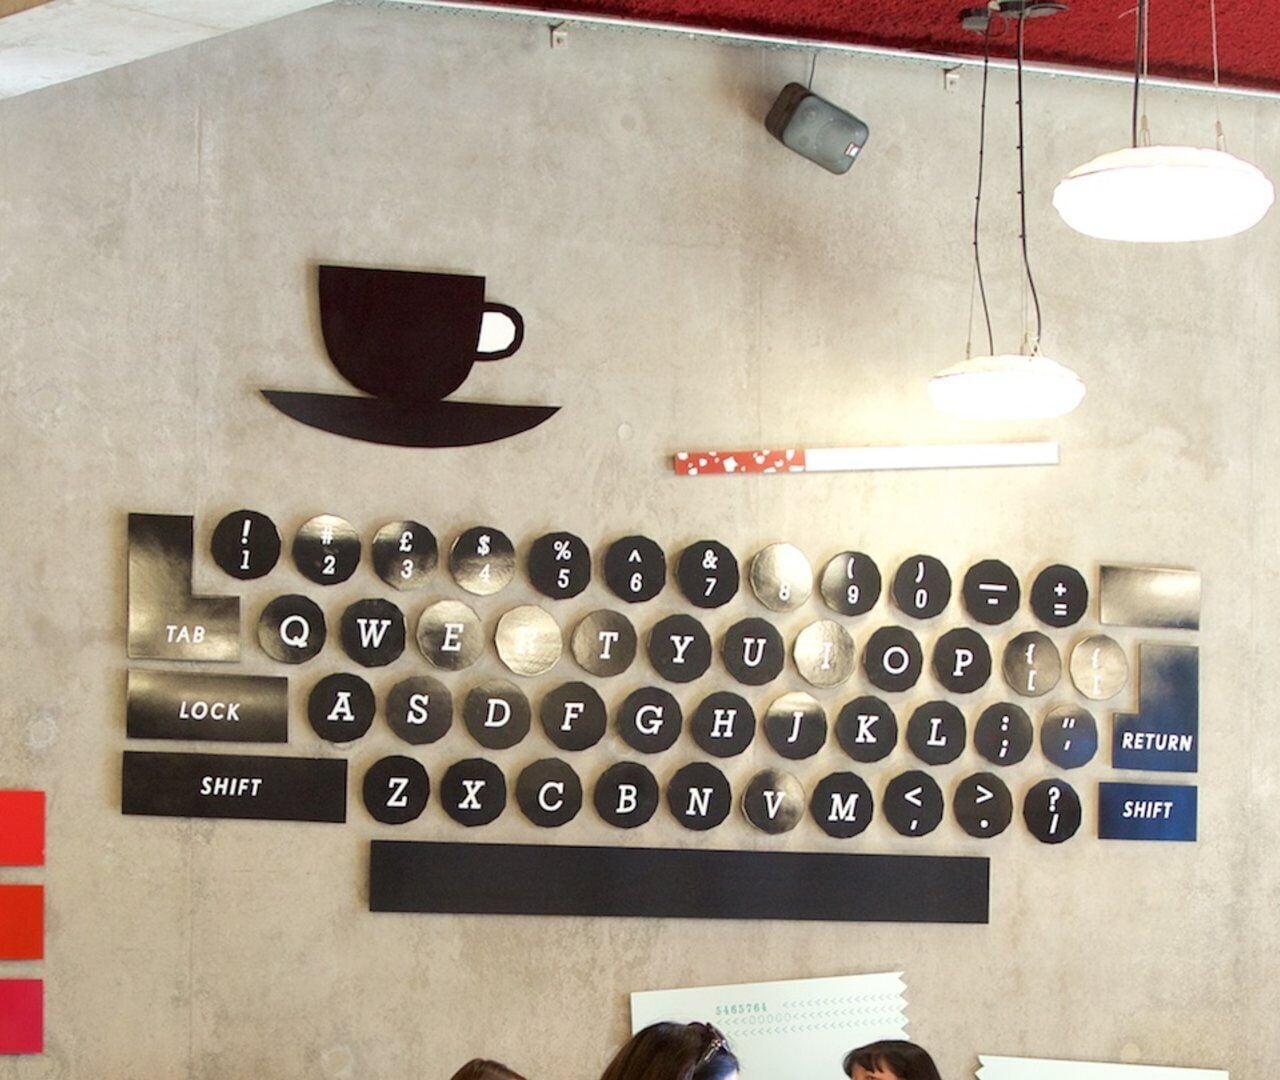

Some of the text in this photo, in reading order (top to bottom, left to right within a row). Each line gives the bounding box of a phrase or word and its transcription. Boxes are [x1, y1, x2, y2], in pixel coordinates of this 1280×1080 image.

[241, 519, 251, 544] !
[320, 526, 334, 546] #
[399, 531, 413, 552] £
[477, 534, 491, 557] $
[240, 549, 250, 570] 1
[553, 540, 572, 561] %
[702, 549, 718, 570] &
[322, 555, 336, 575] 2
[400, 559, 414, 580] 3
[477, 562, 492, 586] 4
[557, 568, 570, 589] 5
[630, 572, 643, 592] 6
[704, 577, 717, 597] 7
[778, 584, 791, 601] 8
[847, 585, 859, 604] 9
[915, 588, 928, 609] 0
[165, 624, 206, 644] TAB
[280, 615, 309, 648] Q
[356, 618, 392, 648] W
[440, 622, 466, 653] E
[598, 631, 619, 660] T
[670, 635, 694, 664] Y
[743, 637, 767, 667] U
[819, 641, 834, 671] I
[883, 646, 909, 675] O
[953, 648, 973, 677] P
[179, 700, 241, 721] LOCK
[327, 691, 355, 721] A
[406, 694, 429, 725] S
[484, 698, 511, 727] D
[561, 702, 584, 731] F
[635, 705, 663, 735] G
[710, 709, 737, 738] H
[787, 712, 805, 743] J
[855, 715, 879, 743] K
[926, 718, 947, 746] L
[1122, 732, 1193, 752] RETURN
[200, 776, 262, 797] SHIFT
[386, 777, 409, 807] Z
[458, 780, 486, 810] X
[538, 781, 564, 811] C
[615, 784, 637, 813] B
[685, 787, 714, 817] N
[763, 790, 788, 820] V
[828, 793, 859, 822] M
[1122, 800, 1173, 819] SHIFT
